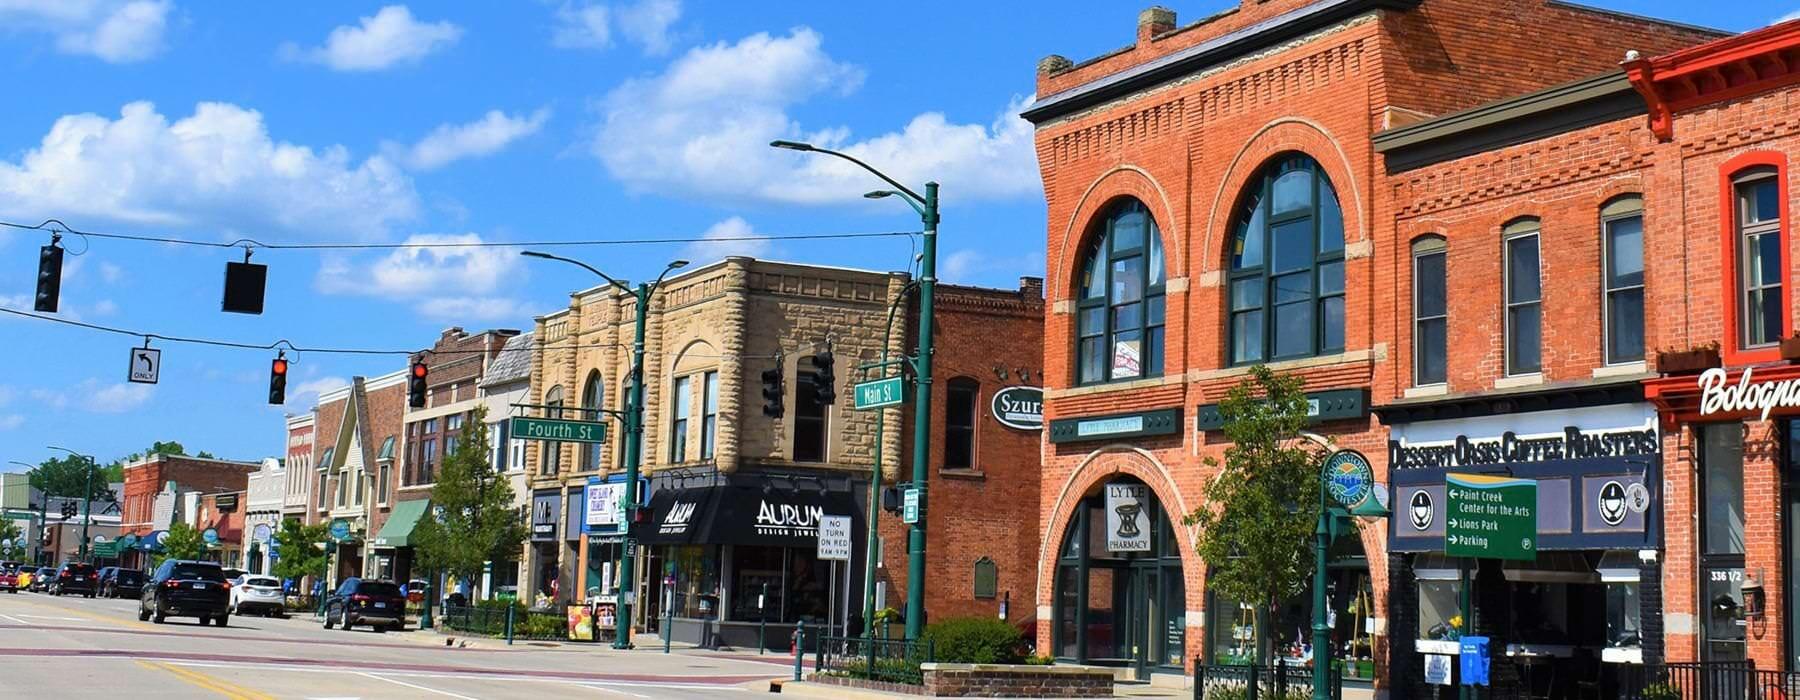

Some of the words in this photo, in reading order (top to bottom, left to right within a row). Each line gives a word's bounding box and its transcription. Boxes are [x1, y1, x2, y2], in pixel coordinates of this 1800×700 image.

[864, 384, 881, 405] Main
[884, 383, 892, 402] St
[528, 421, 572, 439] Fourth
[579, 425, 593, 440] St
[1111, 487, 1145, 498] LYTLE
[1459, 489, 1479, 501] Paint
[1481, 491, 1503, 503] Creek
[756, 499, 824, 526] AURUM
[1459, 502, 1484, 514] Center
[1486, 503, 1498, 515] for
[1500, 504, 1512, 516] the
[1514, 506, 1530, 517] Arts
[829, 520, 841, 528] NO
[1459, 518, 1480, 530] Lions
[1481, 519, 1498, 531] Park
[793, 529, 819, 537] JEWEL
[825, 529, 845, 537] TURN
[820, 538, 831, 546] ON
[833, 539, 848, 547] RED
[1109, 540, 1148, 549] PHARMACY
[1459, 535, 1488, 549] Parking
[1711, 570, 1727, 581] 336
[1728, 570, 1742, 582] 1/2
